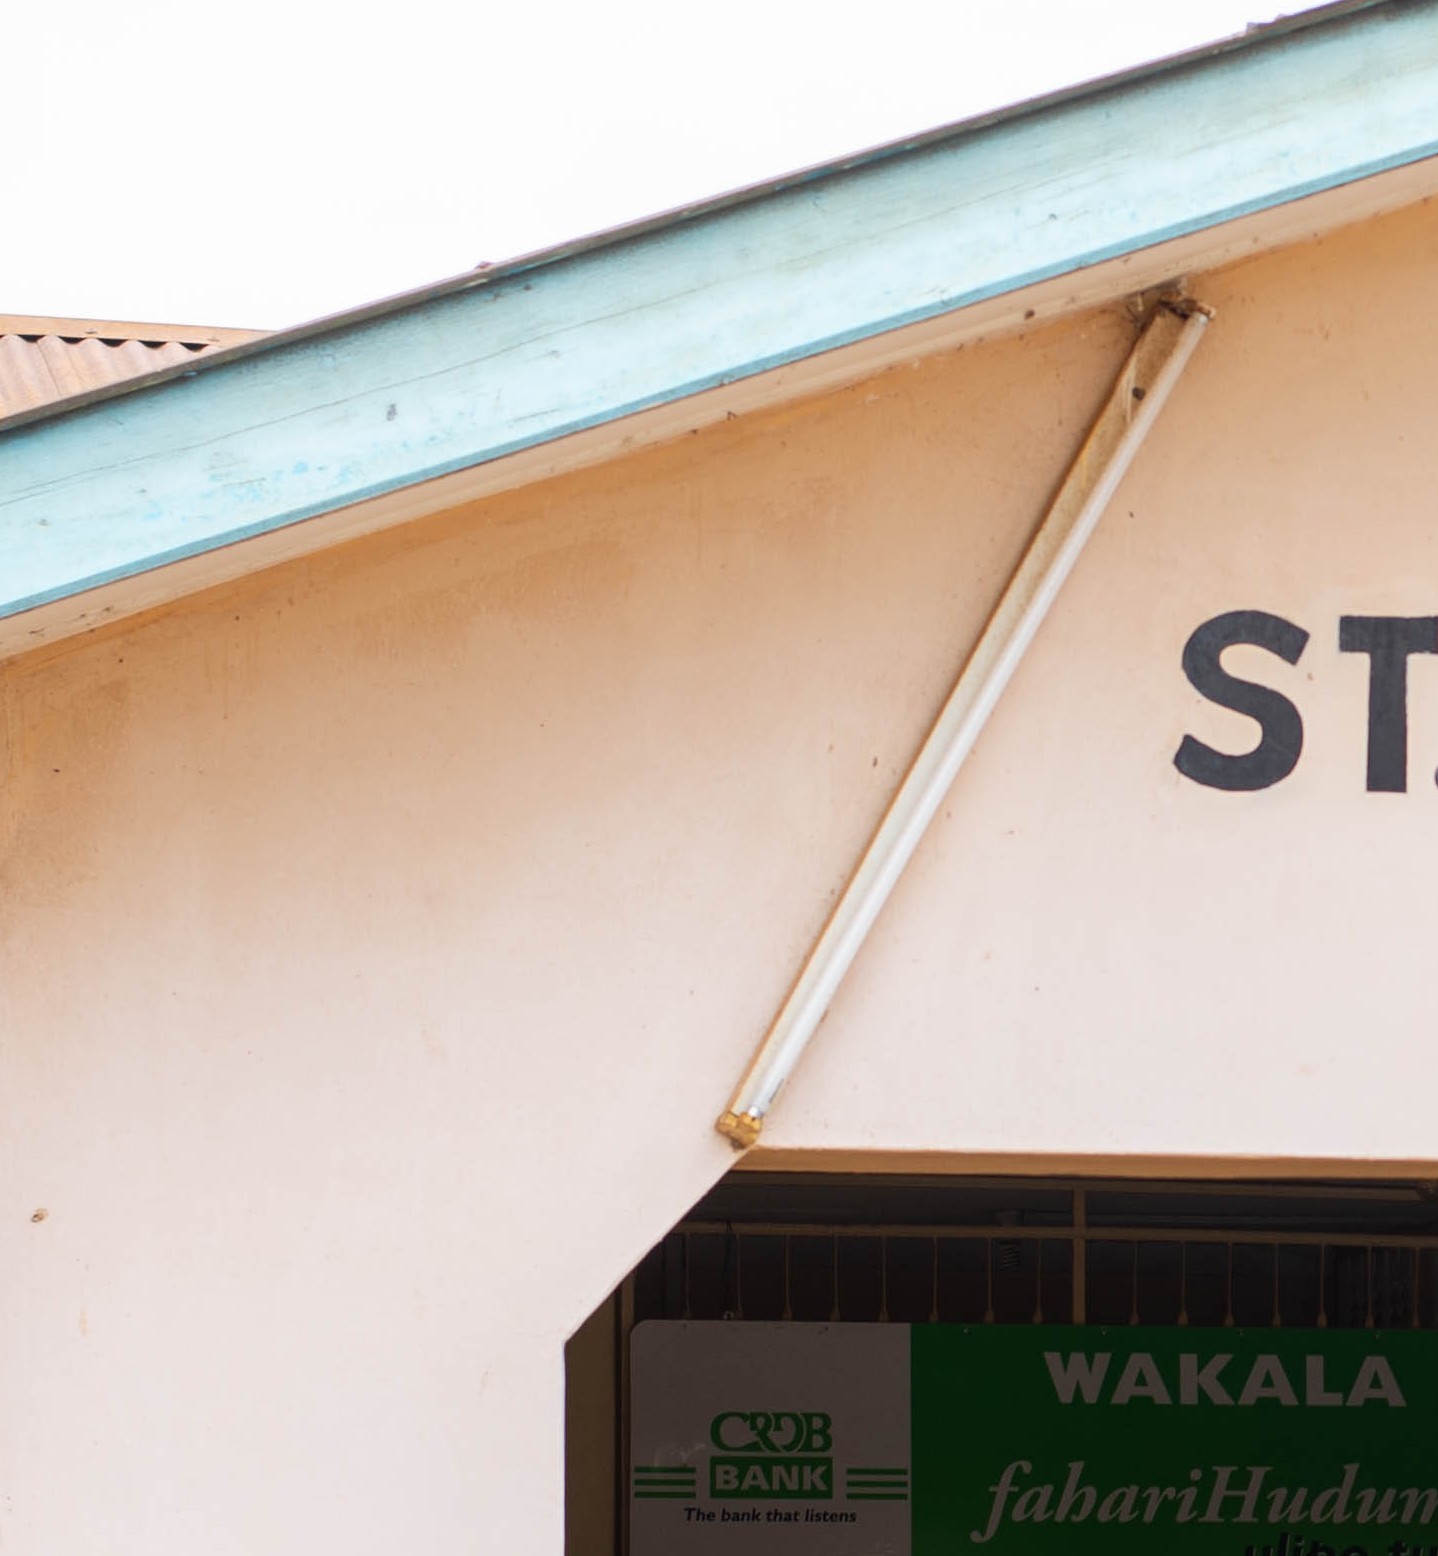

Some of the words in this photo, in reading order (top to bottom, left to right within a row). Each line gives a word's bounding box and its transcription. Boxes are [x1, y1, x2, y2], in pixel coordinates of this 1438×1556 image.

[1044, 1351, 1407, 1408] WAKALA
[714, 1463, 829, 1492] BANK
[683, 1507, 715, 1523] The
[720, 1507, 761, 1523] bank
[766, 1508, 800, 1523] that
[804, 1507, 857, 1523] listens
